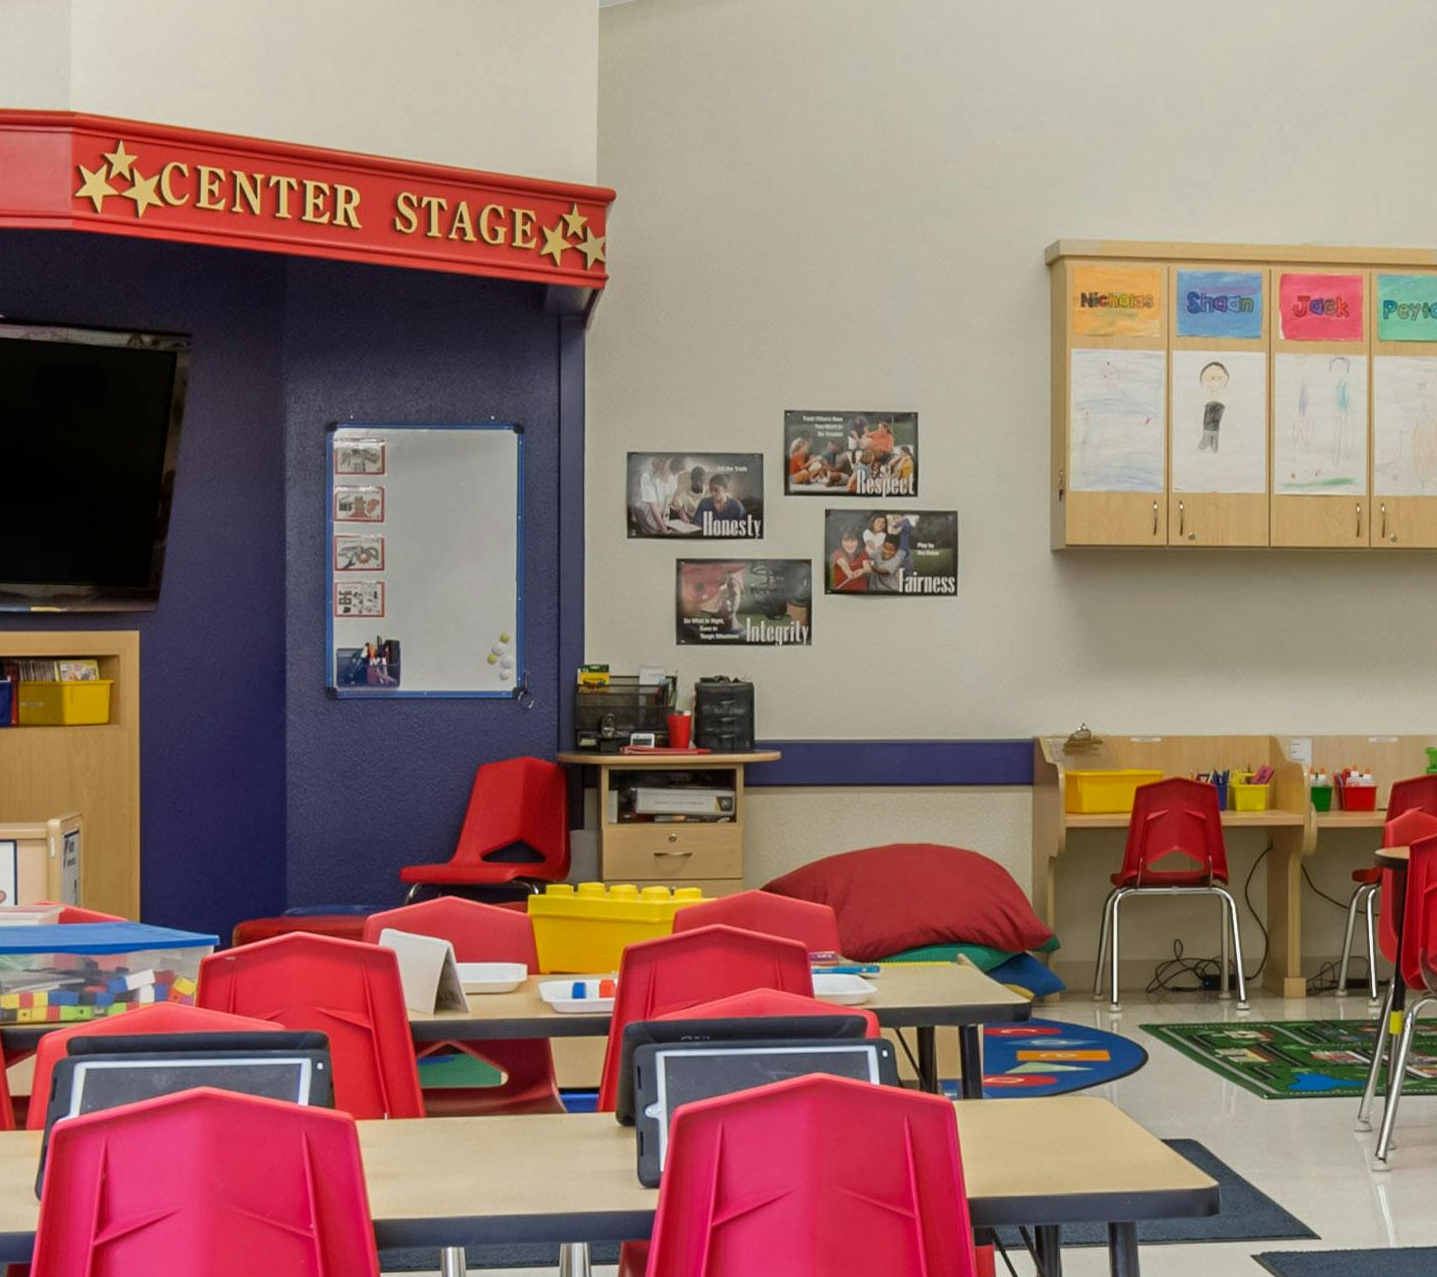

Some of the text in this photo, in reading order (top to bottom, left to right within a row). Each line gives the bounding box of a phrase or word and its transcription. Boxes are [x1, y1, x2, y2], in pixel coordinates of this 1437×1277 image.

[160, 161, 538, 249] CENTER STAGE
[1080, 292, 1154, 309] Nicholas
[1187, 292, 1254, 315] Shaan
[1292, 295, 1350, 319] Jack
[856, 469, 914, 497] Respect
[703, 511, 761, 539] Honesty
[899, 568, 955, 593] Fairness
[747, 617, 809, 645] Integrity
